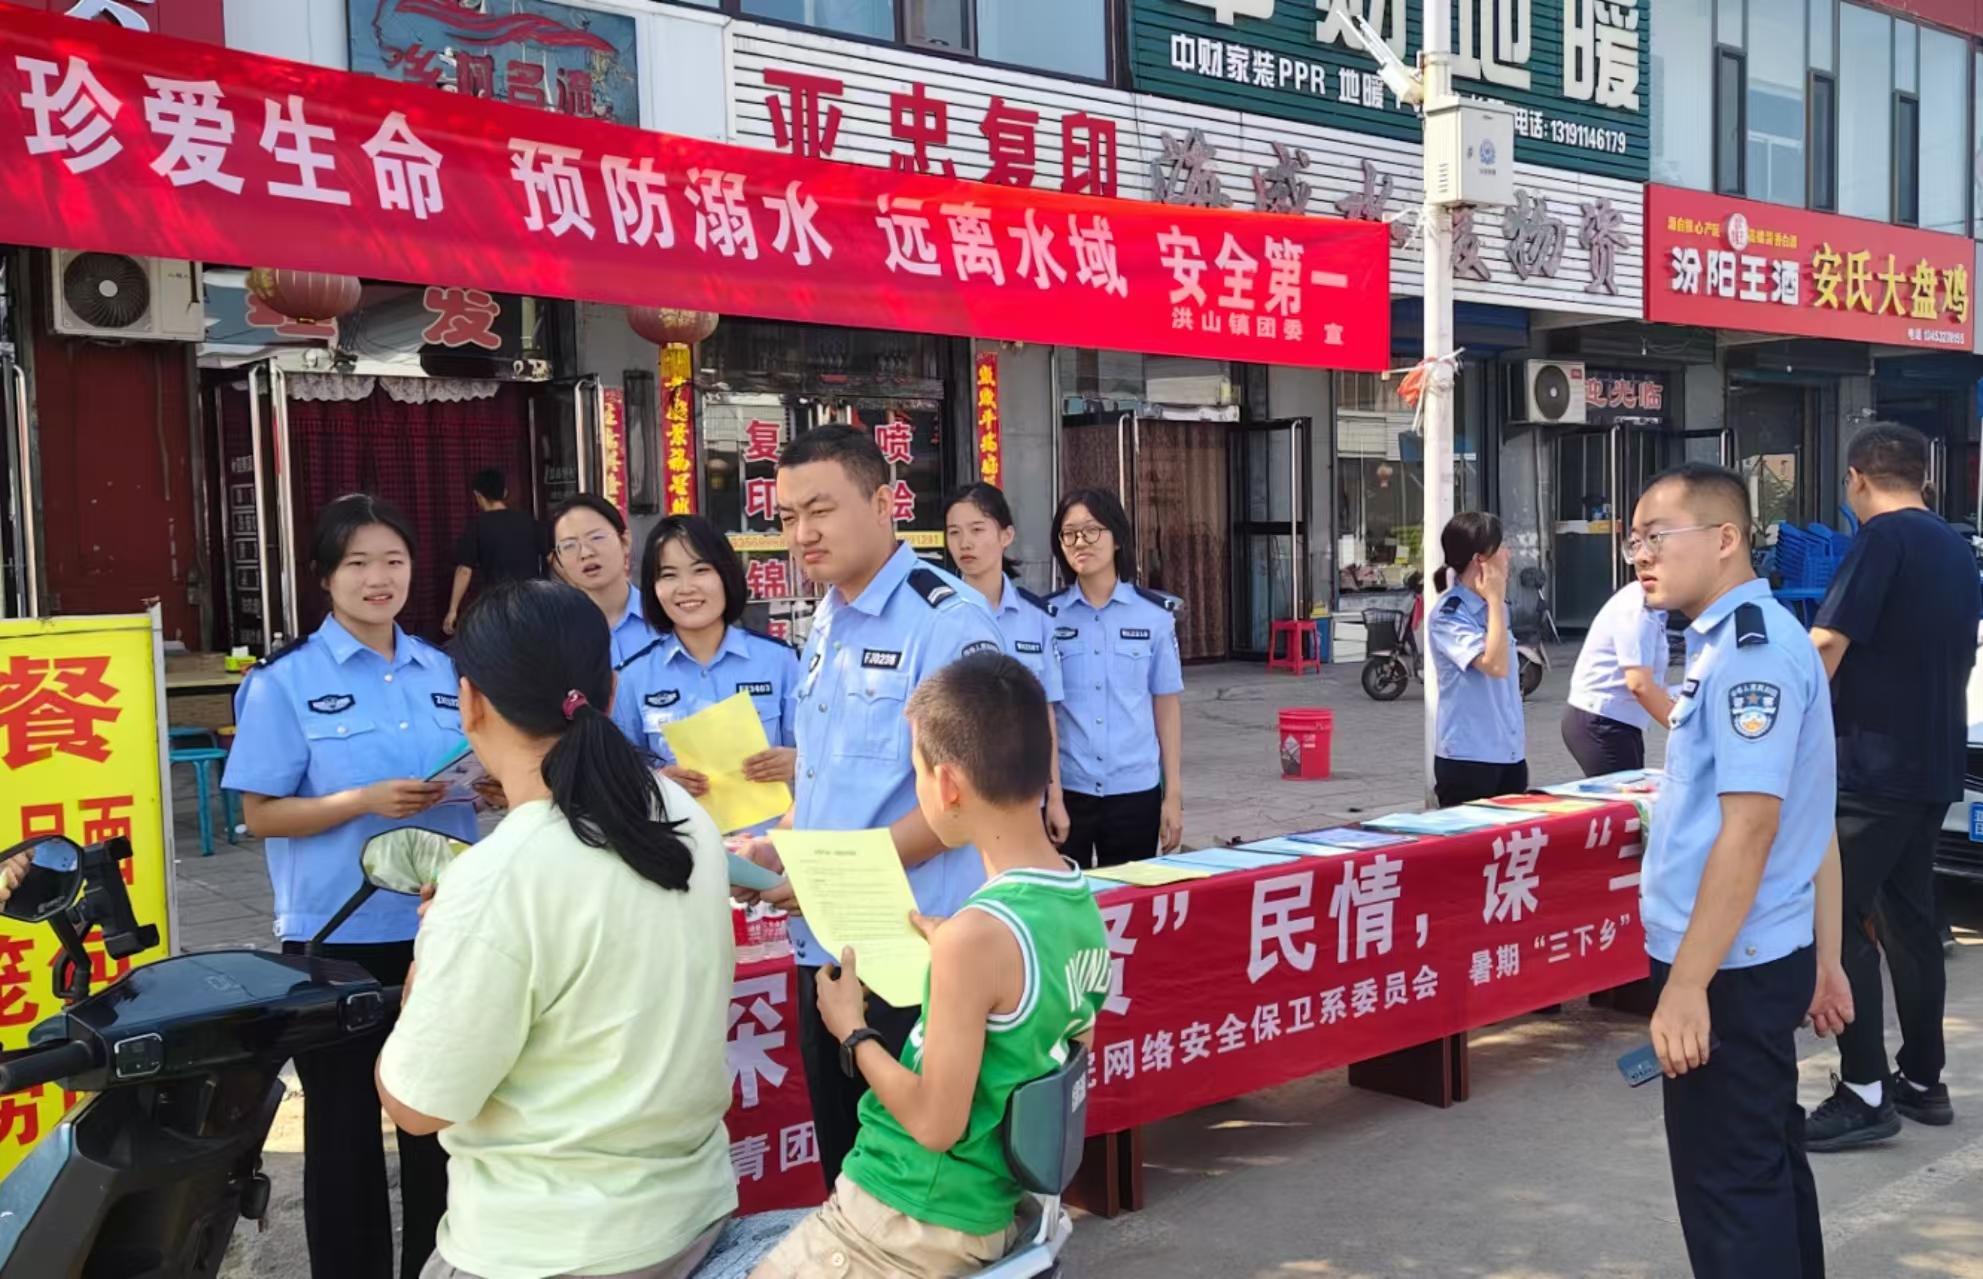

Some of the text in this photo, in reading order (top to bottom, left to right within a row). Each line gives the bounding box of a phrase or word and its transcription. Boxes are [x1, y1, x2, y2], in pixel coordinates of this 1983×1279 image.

[1170, 33, 1326, 95] 中财家装PPR
[763, 68, 1117, 198] 亚忠复印
[15, 55, 1349, 316] 珍爱生命 预防溺水 远离水域 安全第一
[1671, 246, 1800, 305] 汾阳王酒
[1812, 242, 1969, 324] 安氏大盘鸡
[1171, 307, 1344, 346] 洪山镇团委 宣
[1586, 377, 1664, 411] 迎光临
[0, 656, 123, 772] 餐
